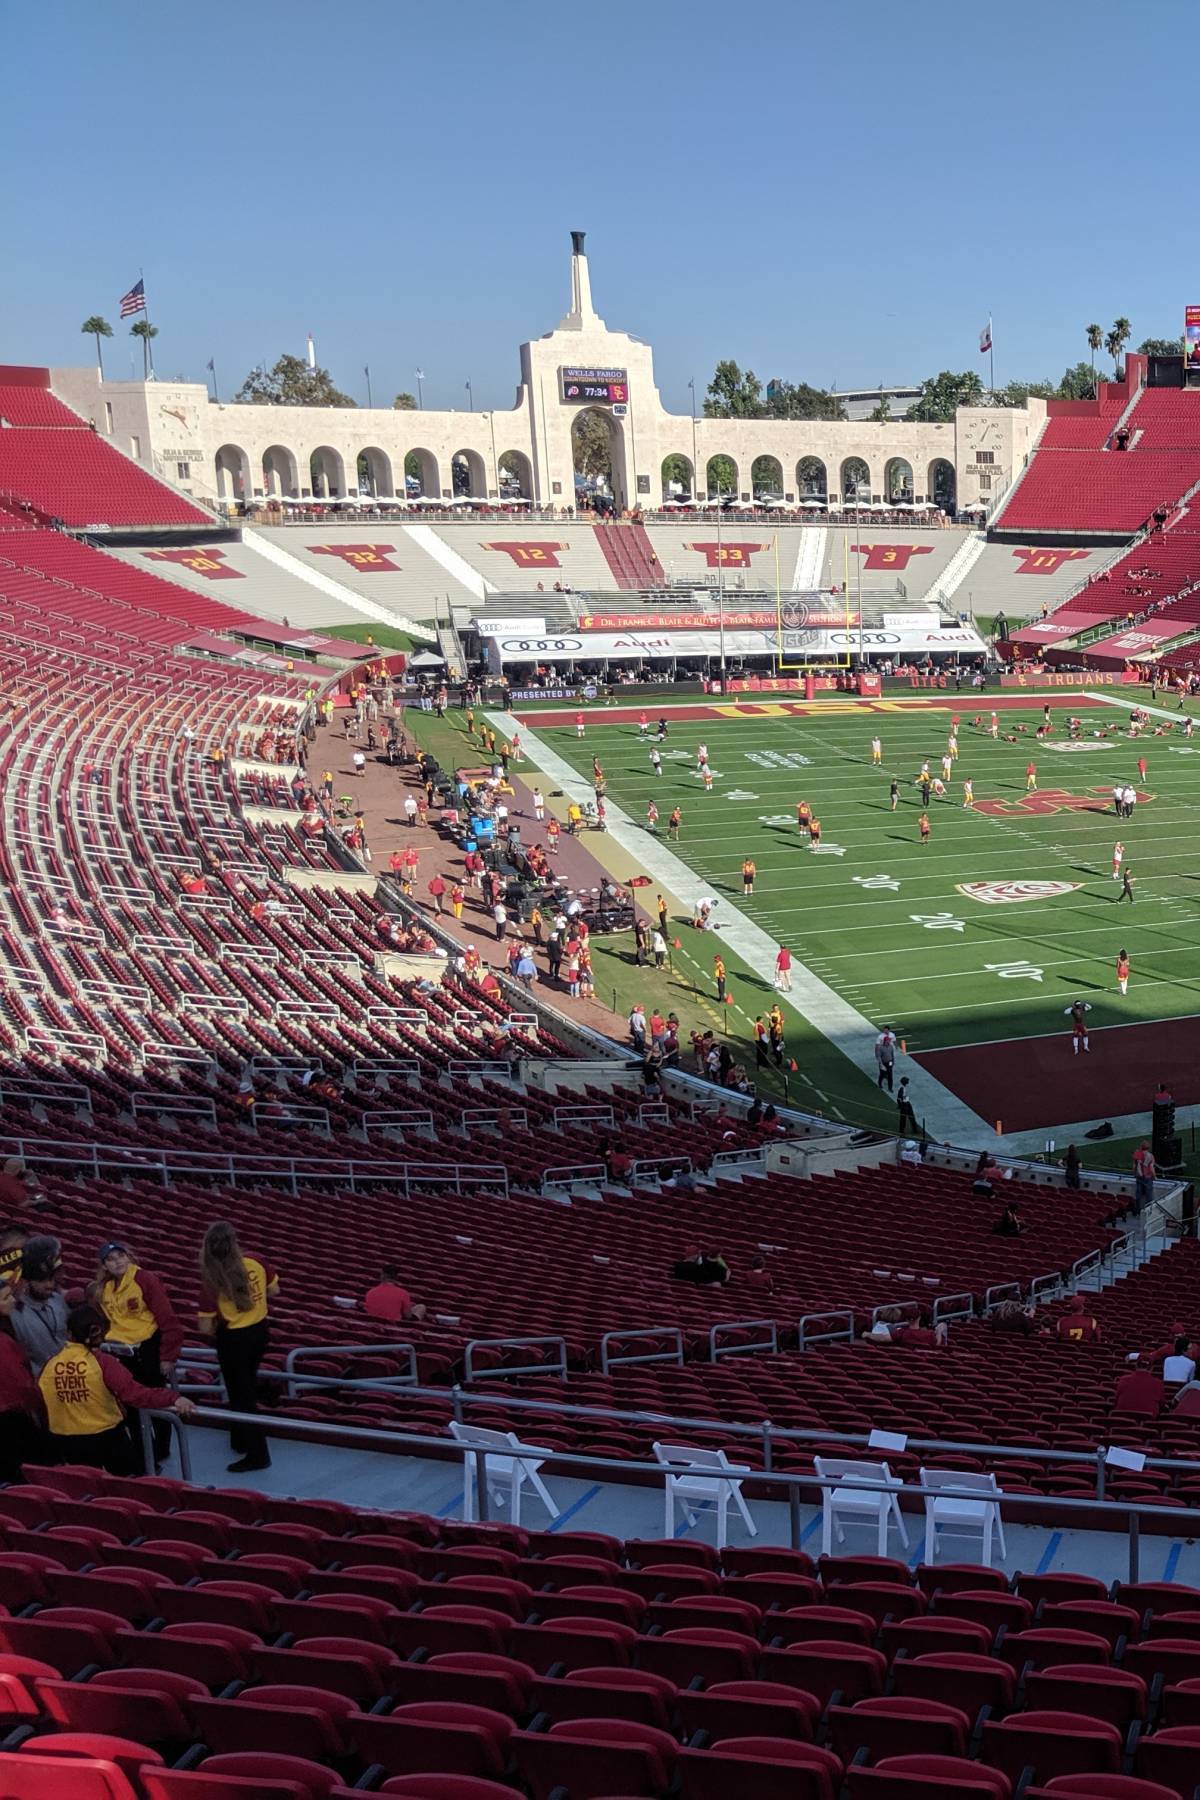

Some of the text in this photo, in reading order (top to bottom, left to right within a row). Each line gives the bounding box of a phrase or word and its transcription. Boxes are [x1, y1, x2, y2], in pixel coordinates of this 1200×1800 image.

[568, 369, 622, 378] WELLS FARGO
[585, 387, 608, 397] 77:34
[345, 551, 386, 563] 32
[517, 548, 548, 560] 12
[714, 549, 743, 560] 33
[882, 551, 898, 562] 3
[182, 557, 222, 570] 20
[613, 638, 671, 648] Audi
[926, 633, 975, 642] Audi
[911, 676, 947, 688] UTES
[1046, 672, 1114, 686] TROJANS
[511, 688, 577, 700] PRESENTED BY
[709, 700, 954, 718] USC
[852, 874, 900, 890] 30
[909, 911, 966, 931] 20
[983, 960, 1044, 979] 10
[54, 1361, 88, 1375] CSC
[55, 1375, 87, 1390] EVENT
[56, 1389, 90, 1403] STAFF
